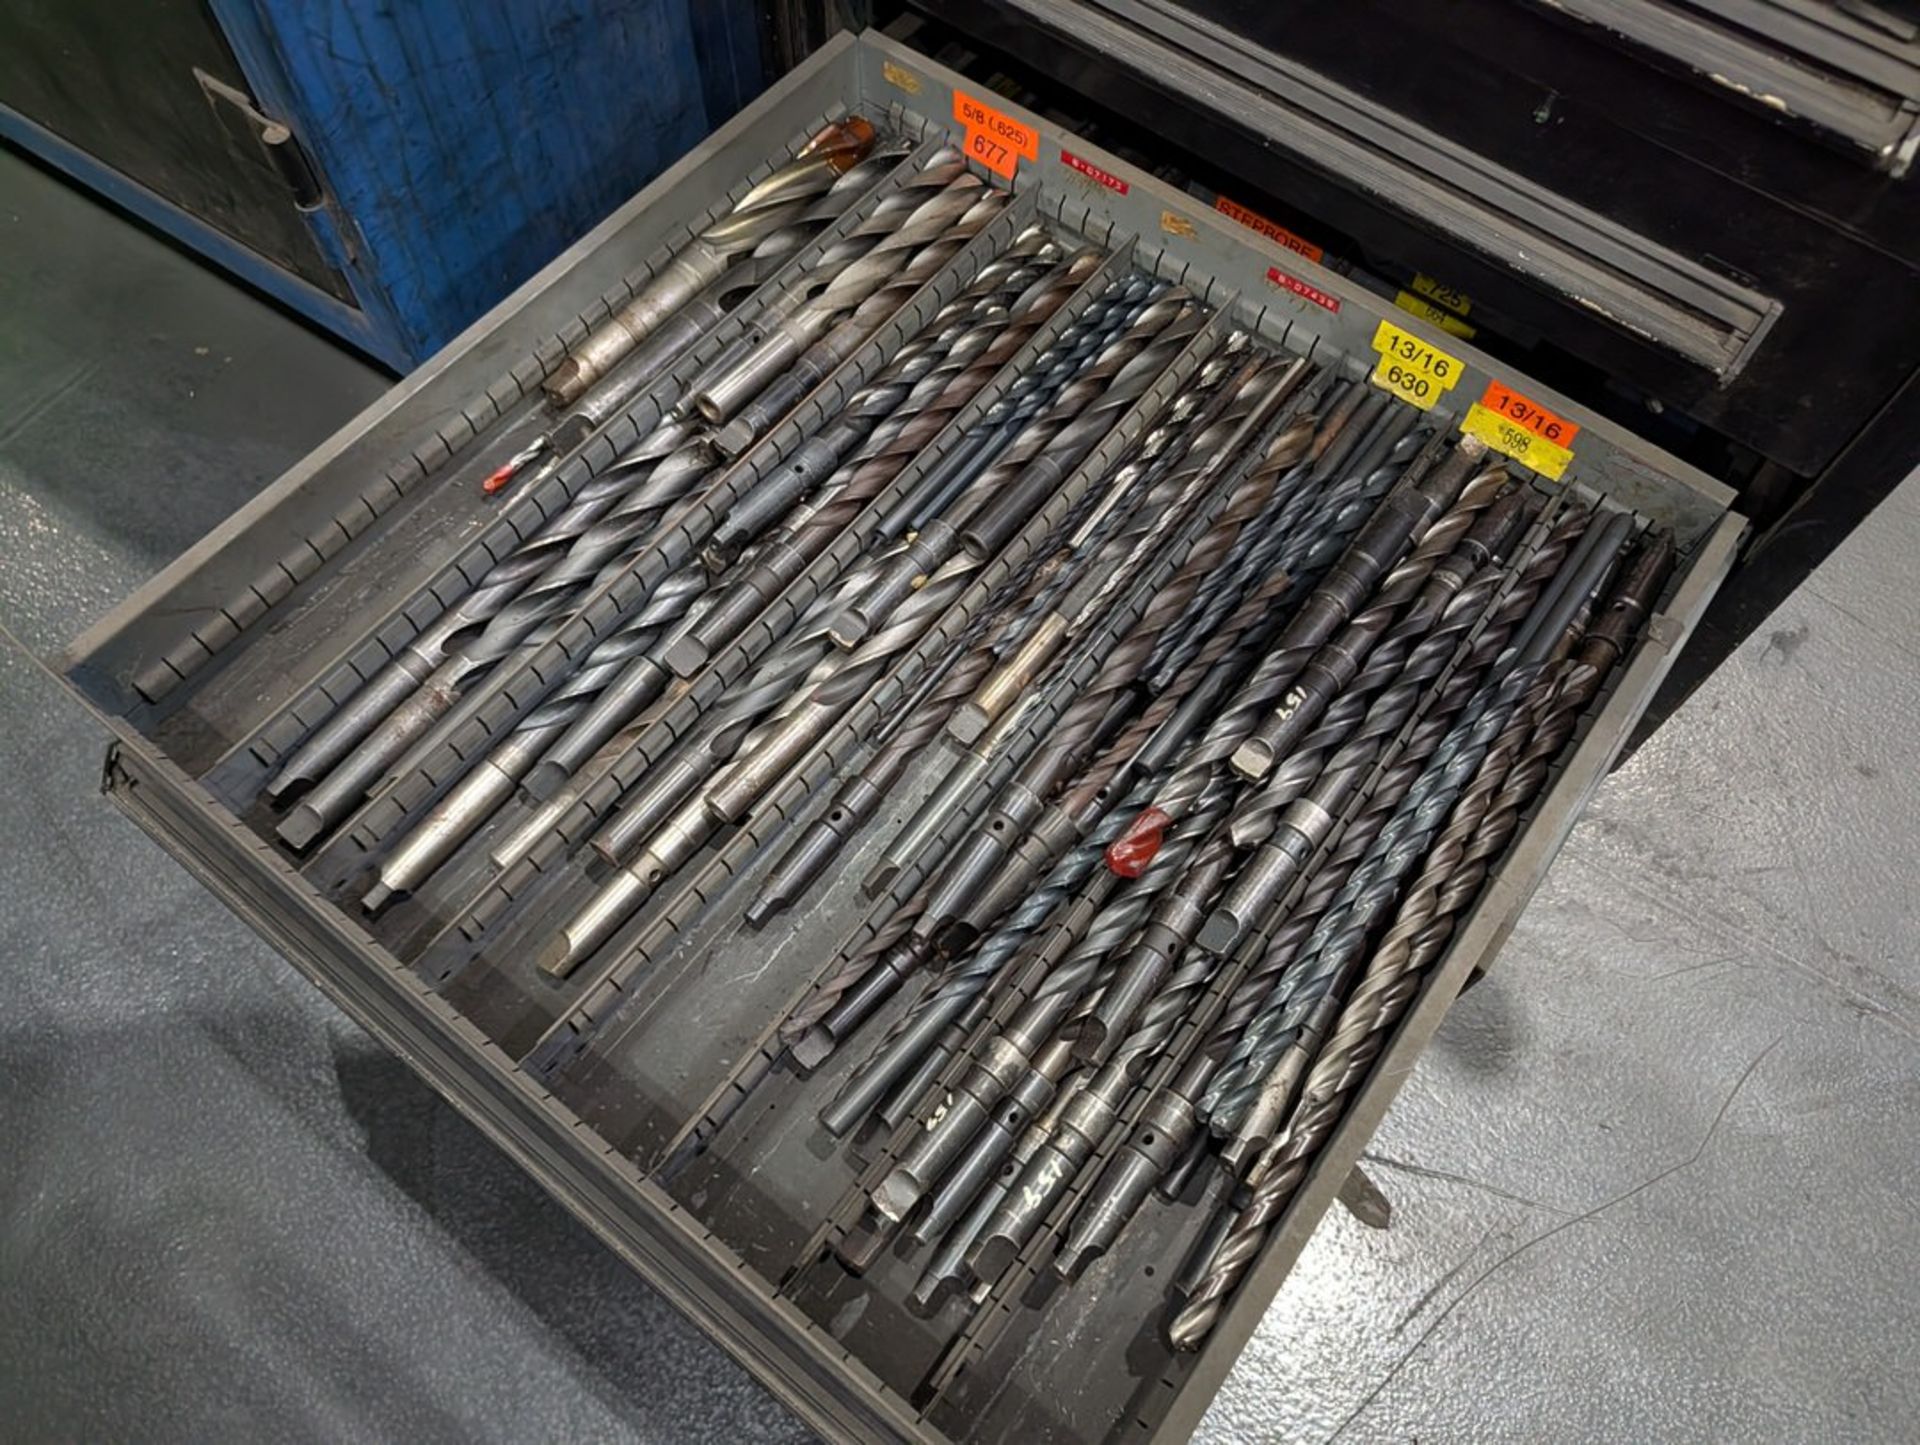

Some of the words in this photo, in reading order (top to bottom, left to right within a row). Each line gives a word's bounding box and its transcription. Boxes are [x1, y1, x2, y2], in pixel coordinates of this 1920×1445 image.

[963, 102, 984, 125] 5/8
[988, 118, 1029, 147] (.625)
[973, 135, 1008, 164] 677
[1390, 335, 1450, 378] 13/16
[1388, 365, 1429, 398] 630
[1499, 395, 1562, 440] 13/16
